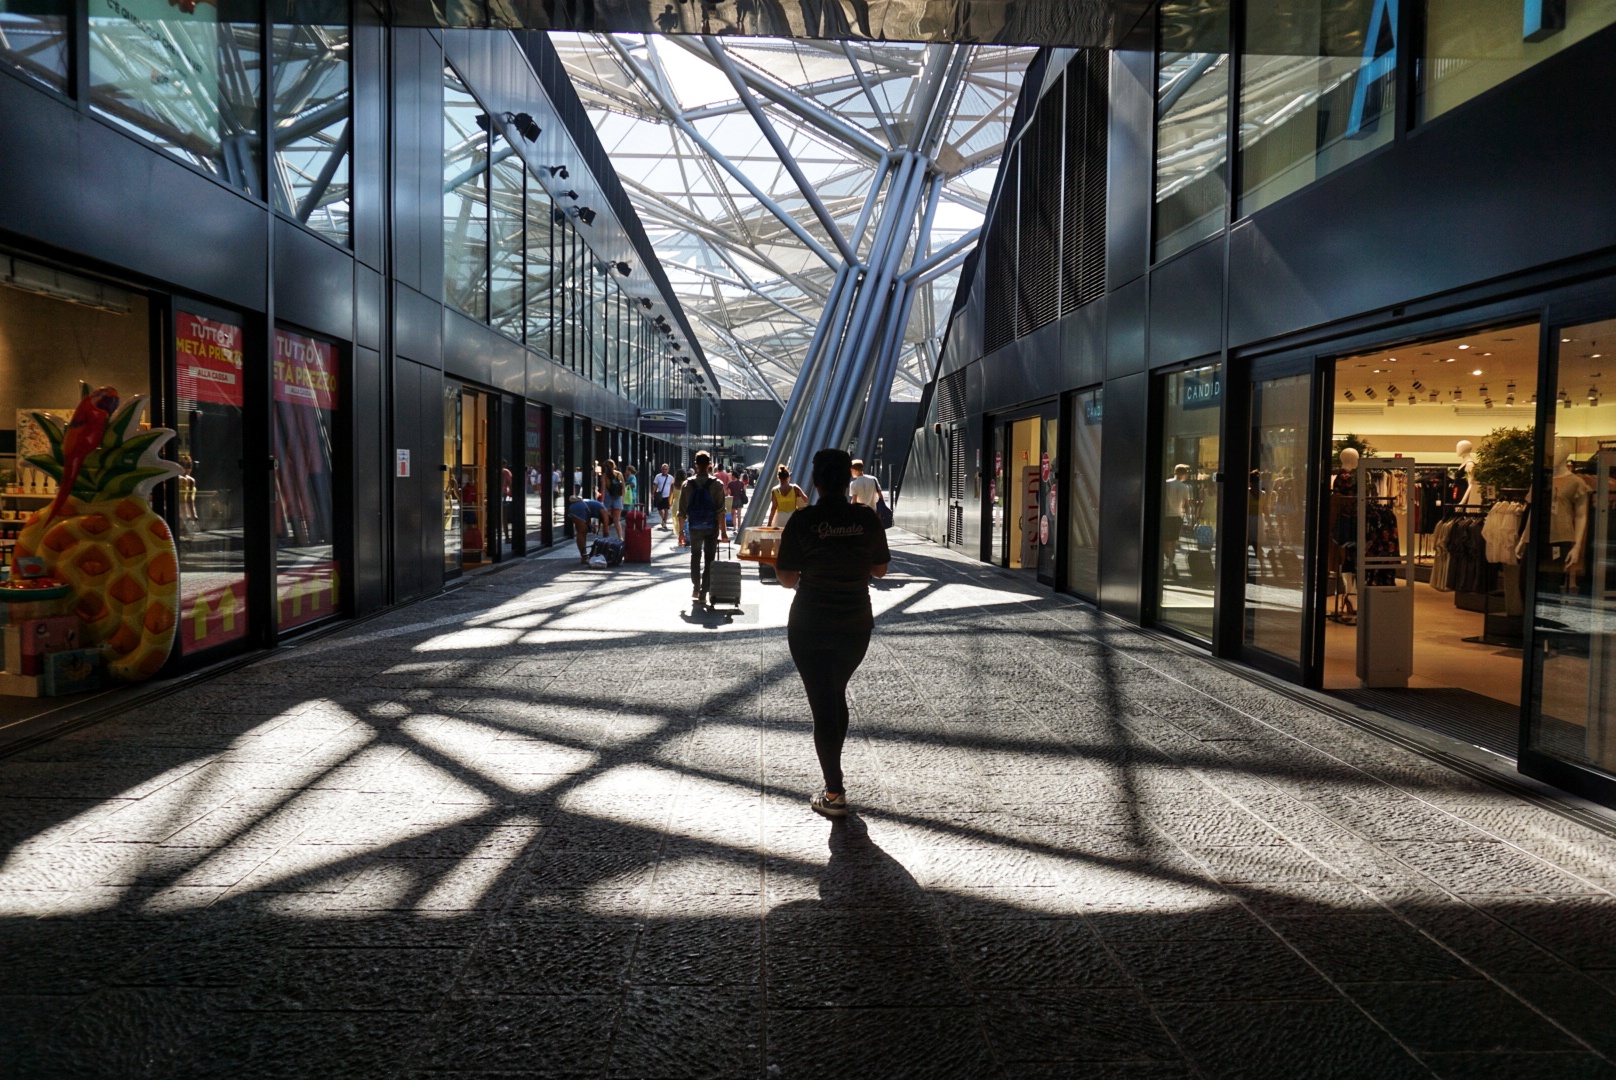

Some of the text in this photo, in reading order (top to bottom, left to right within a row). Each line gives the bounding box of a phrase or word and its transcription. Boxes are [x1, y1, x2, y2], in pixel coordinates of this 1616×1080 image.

[190, 322, 225, 344] TUTTO
[176, 336, 207, 358] METÀ
[276, 335, 314, 364] TUTTO
[197, 369, 229, 382] ALLA CASSA
[295, 366, 337, 392] PREZZO
[1186, 381, 1221, 400] CANDID
